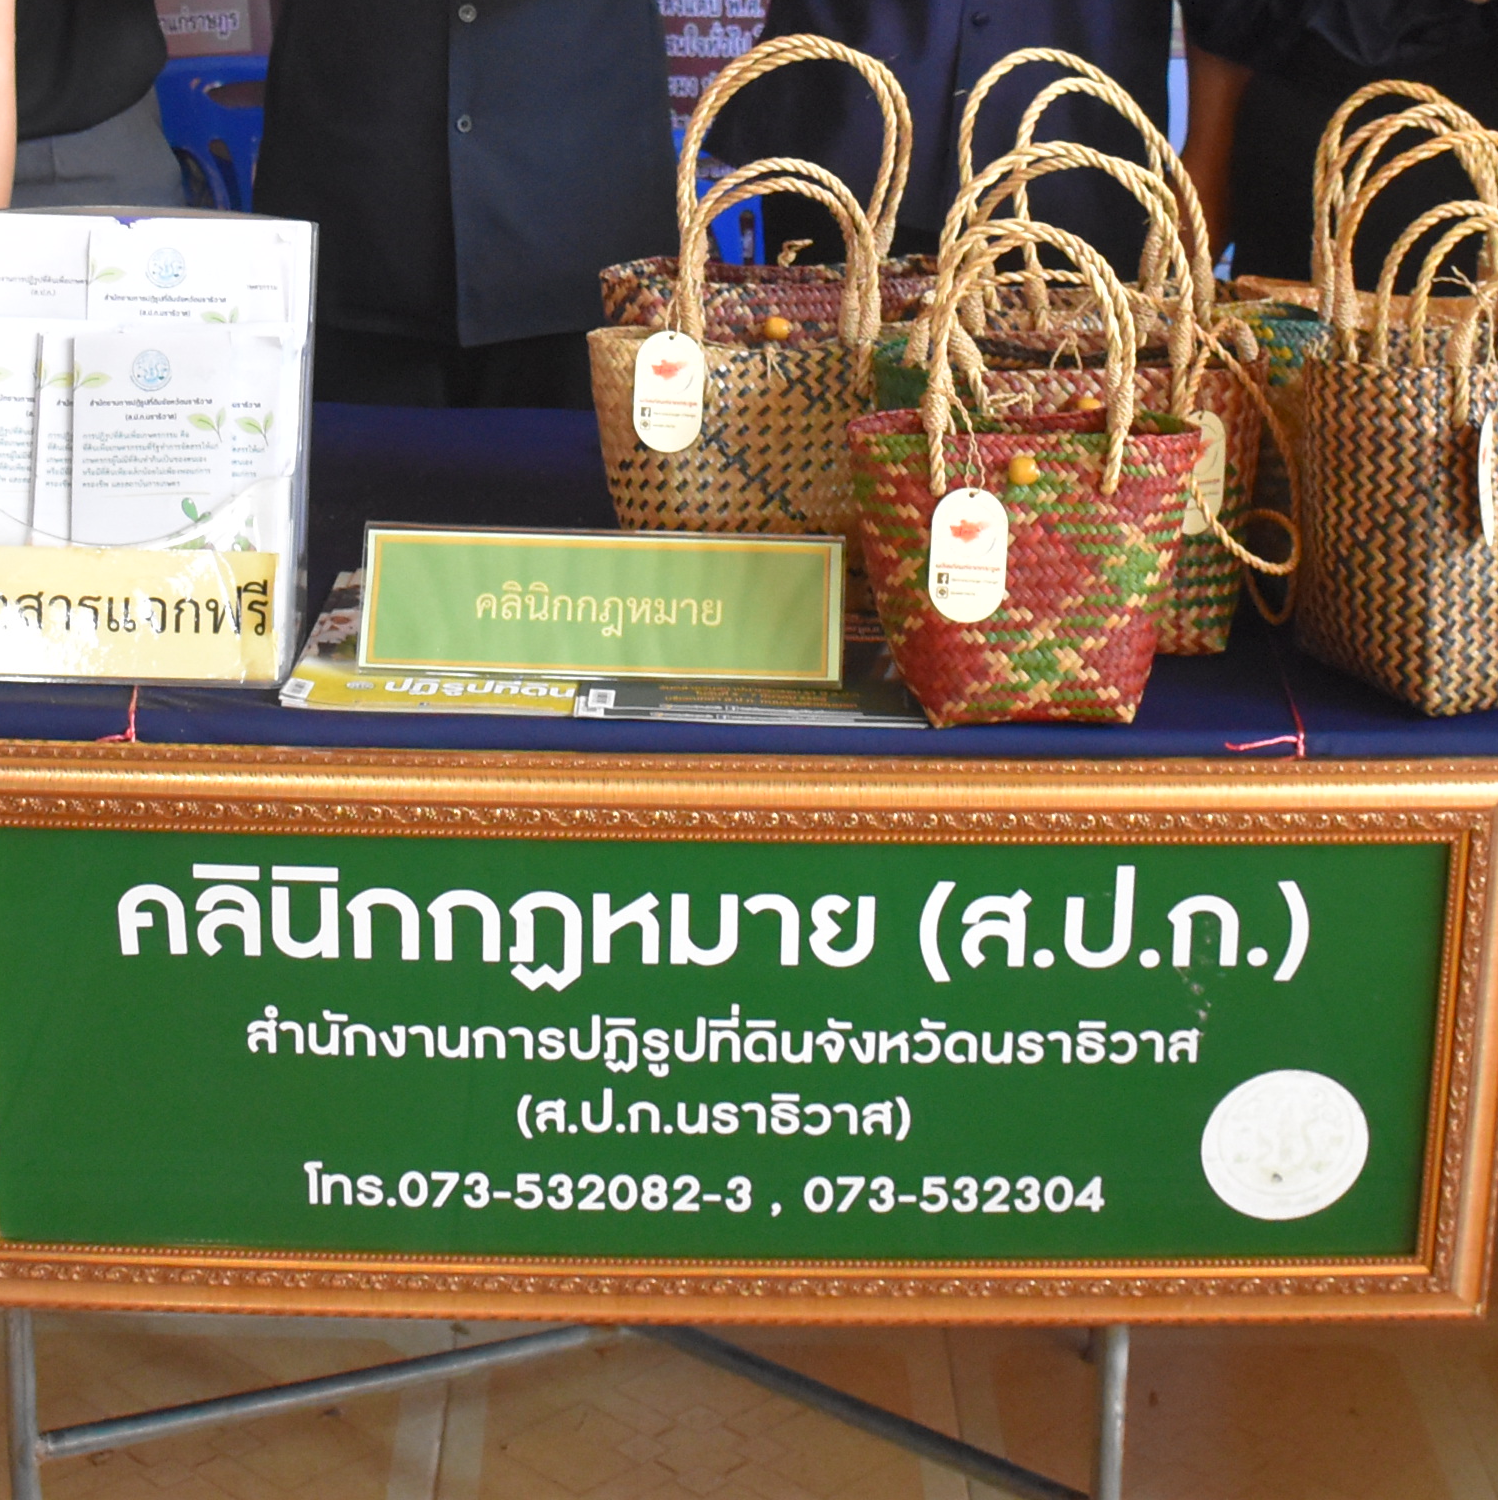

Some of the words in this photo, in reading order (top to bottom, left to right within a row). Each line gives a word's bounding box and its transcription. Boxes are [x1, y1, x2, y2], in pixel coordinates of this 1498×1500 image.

[476, 580, 723, 637] คลินิกกฎหมาย
[117, 862, 877, 992] คลินิกกฏหมาย
[918, 865, 1311, 984] (ส.ป.ก.)
[247, 1003, 1201, 1077] สำนักงานการปฏิรูปที่ดินจังหวัดนราธิวาส
[516, 1088, 911, 1140] (ส.ป.ก.นราธิวาส)
[303, 1161, 752, 1213] โทร.073-532082-3
[803, 1175, 1106, 1214] 073-532304
